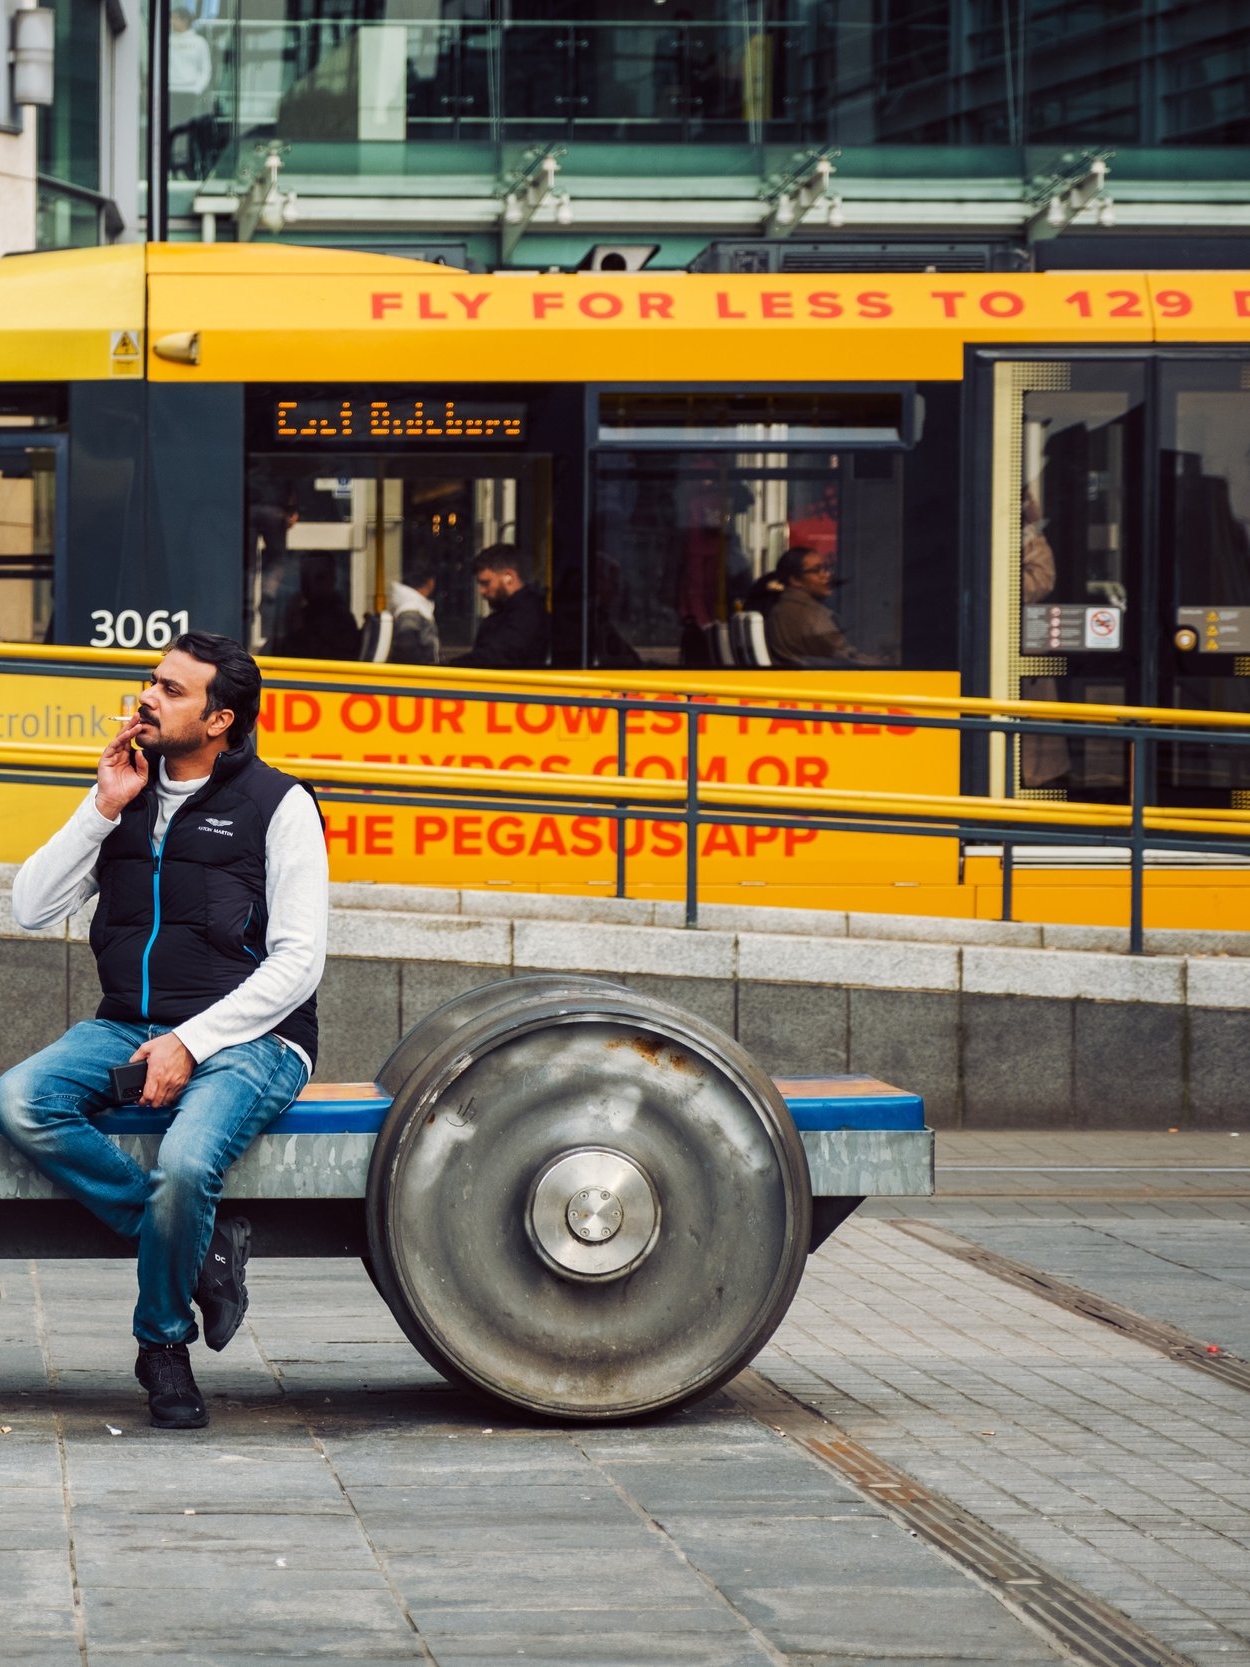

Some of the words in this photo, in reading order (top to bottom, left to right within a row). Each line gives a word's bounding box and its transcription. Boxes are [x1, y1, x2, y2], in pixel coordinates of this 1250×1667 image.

[370, 291, 492, 320] FLY
[532, 291, 676, 320] FOR
[716, 290, 894, 320] LESS
[931, 290, 1025, 319] TO
[1065, 289, 1193, 318] 129
[90, 608, 189, 649] 3061
[340, 692, 467, 734] OUR
[747, 755, 830, 789] OR
[323, 814, 394, 856] HE
[414, 814, 684, 858] PEGASUS
[700, 818, 819, 858] APP
